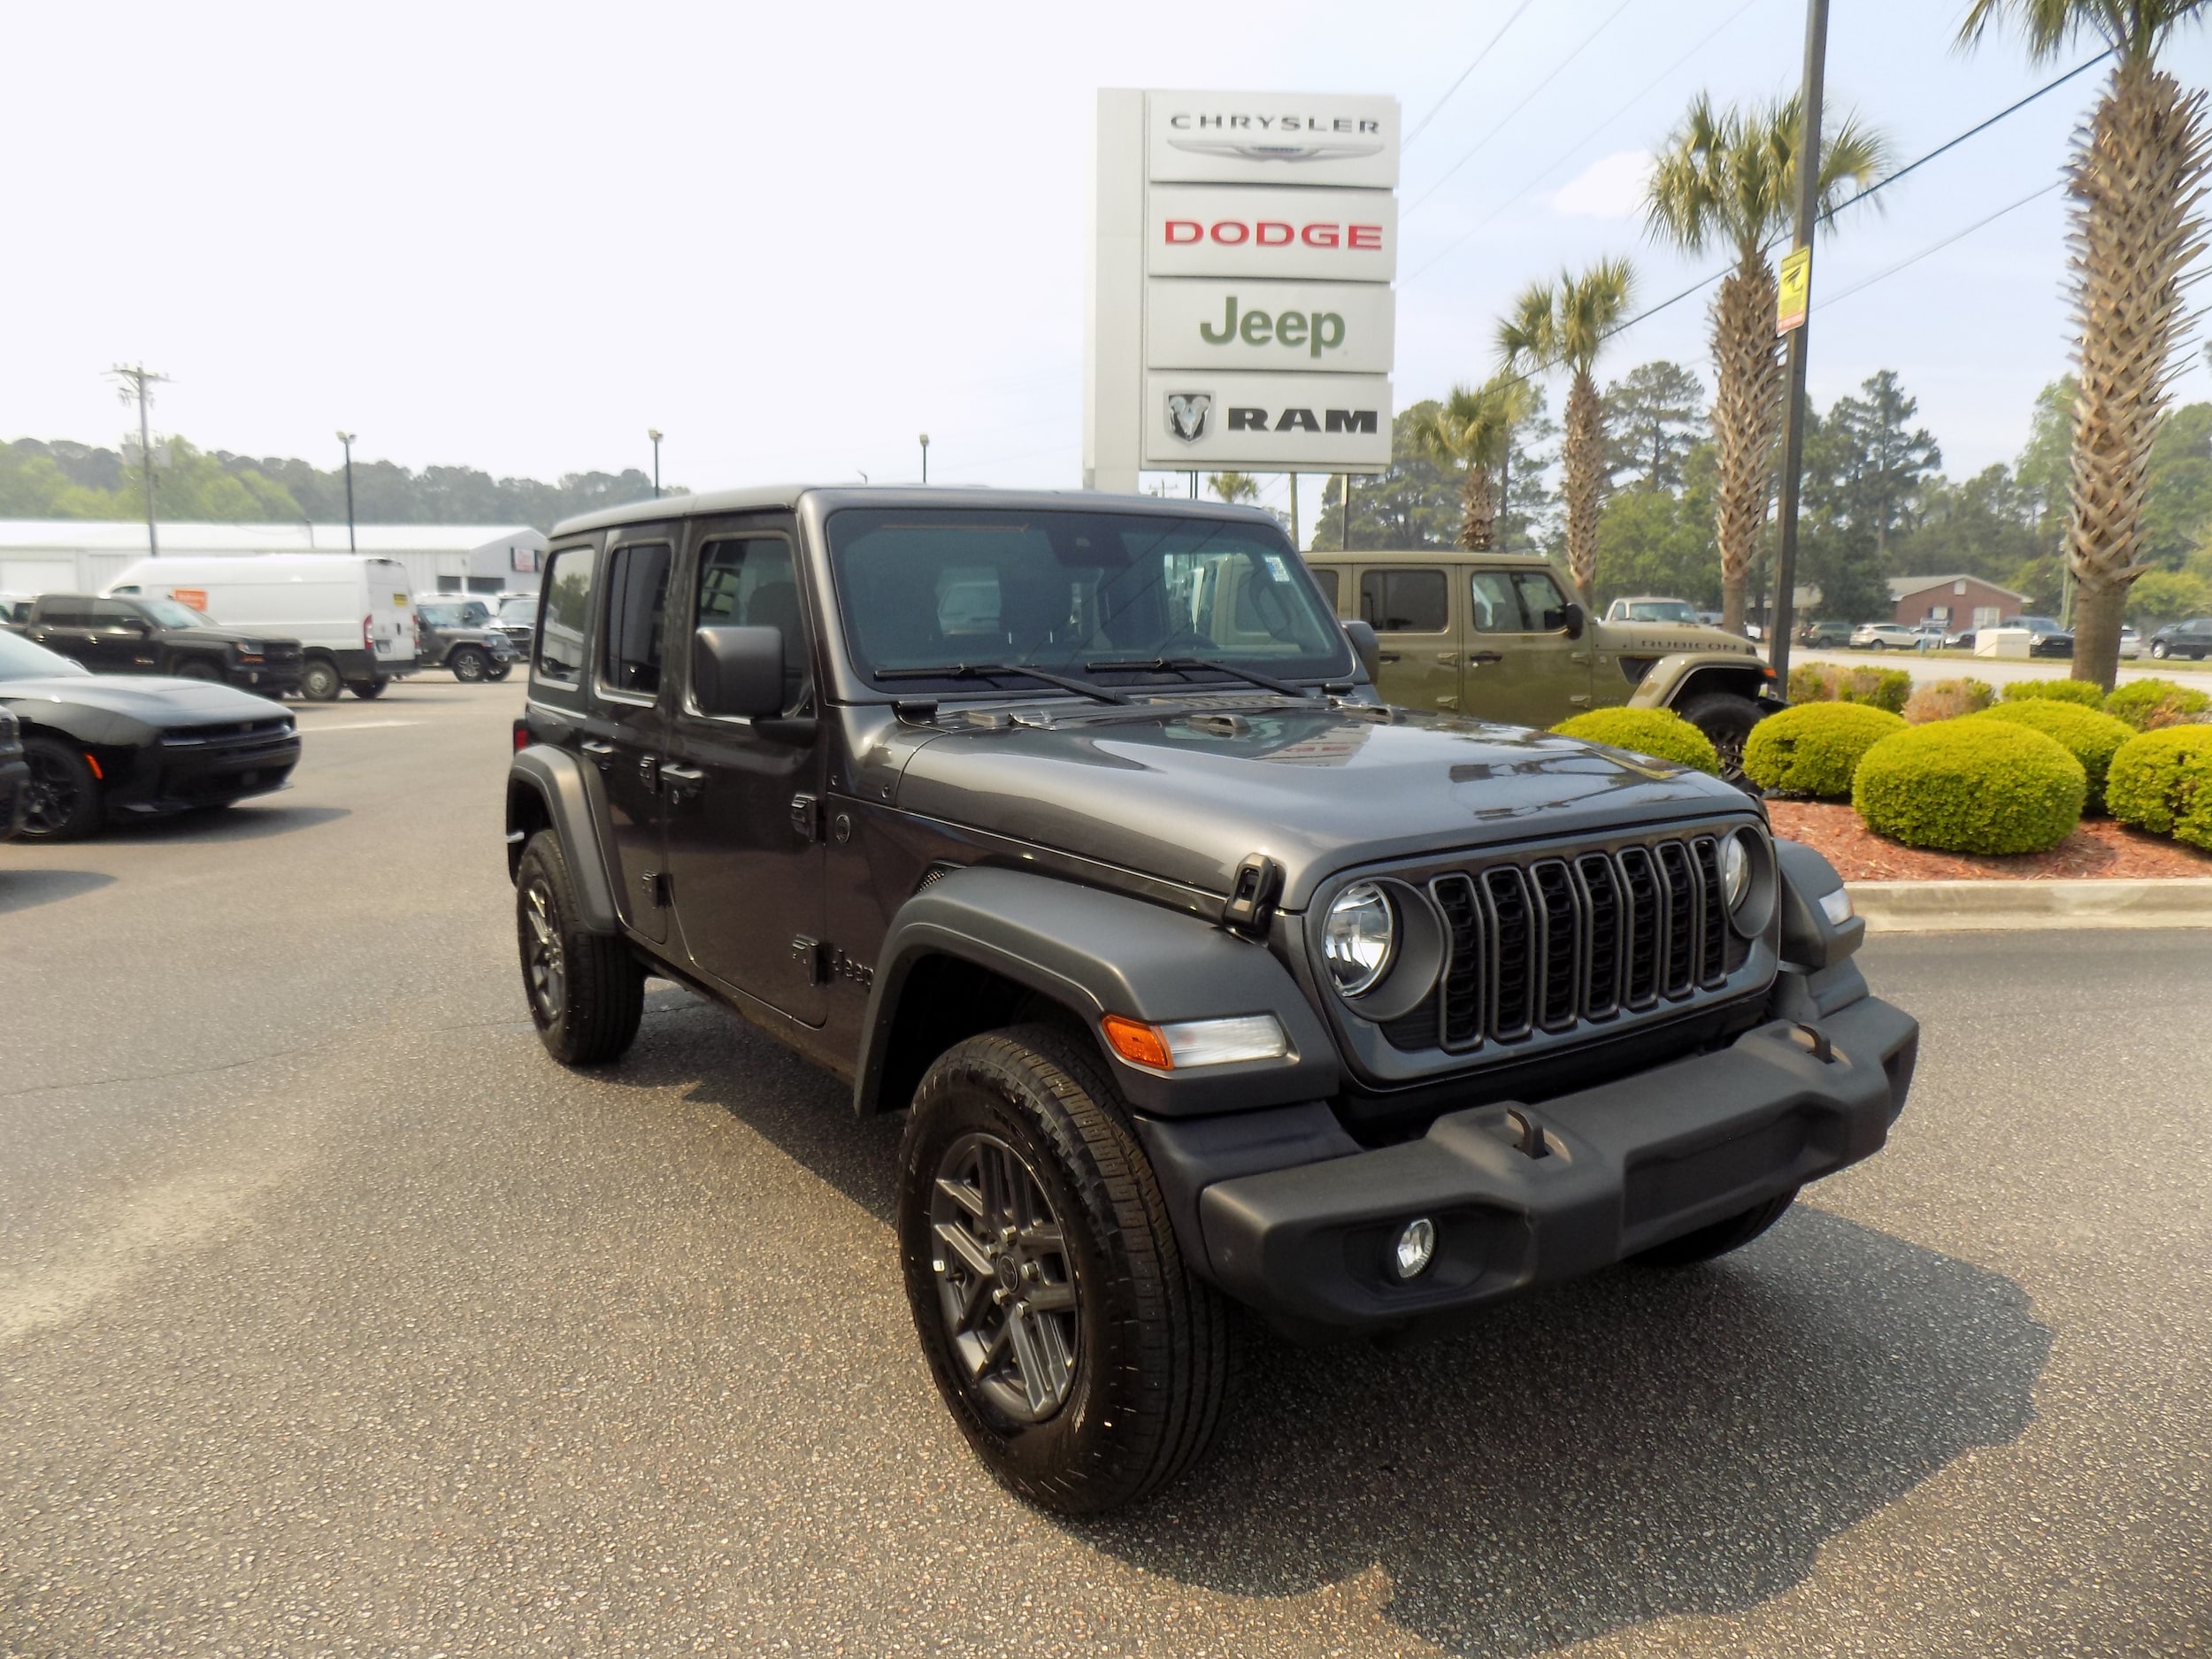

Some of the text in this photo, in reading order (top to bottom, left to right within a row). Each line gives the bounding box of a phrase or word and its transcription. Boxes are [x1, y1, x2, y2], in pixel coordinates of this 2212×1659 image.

[1171, 114, 1379, 134] CHRYSLER
[1165, 221, 1383, 250] DODGE
[1200, 296, 1346, 357] Jeep
[1227, 407, 1378, 434] RAM
[1641, 640, 1737, 651] RUBICON
[832, 949, 875, 995] Jeep
